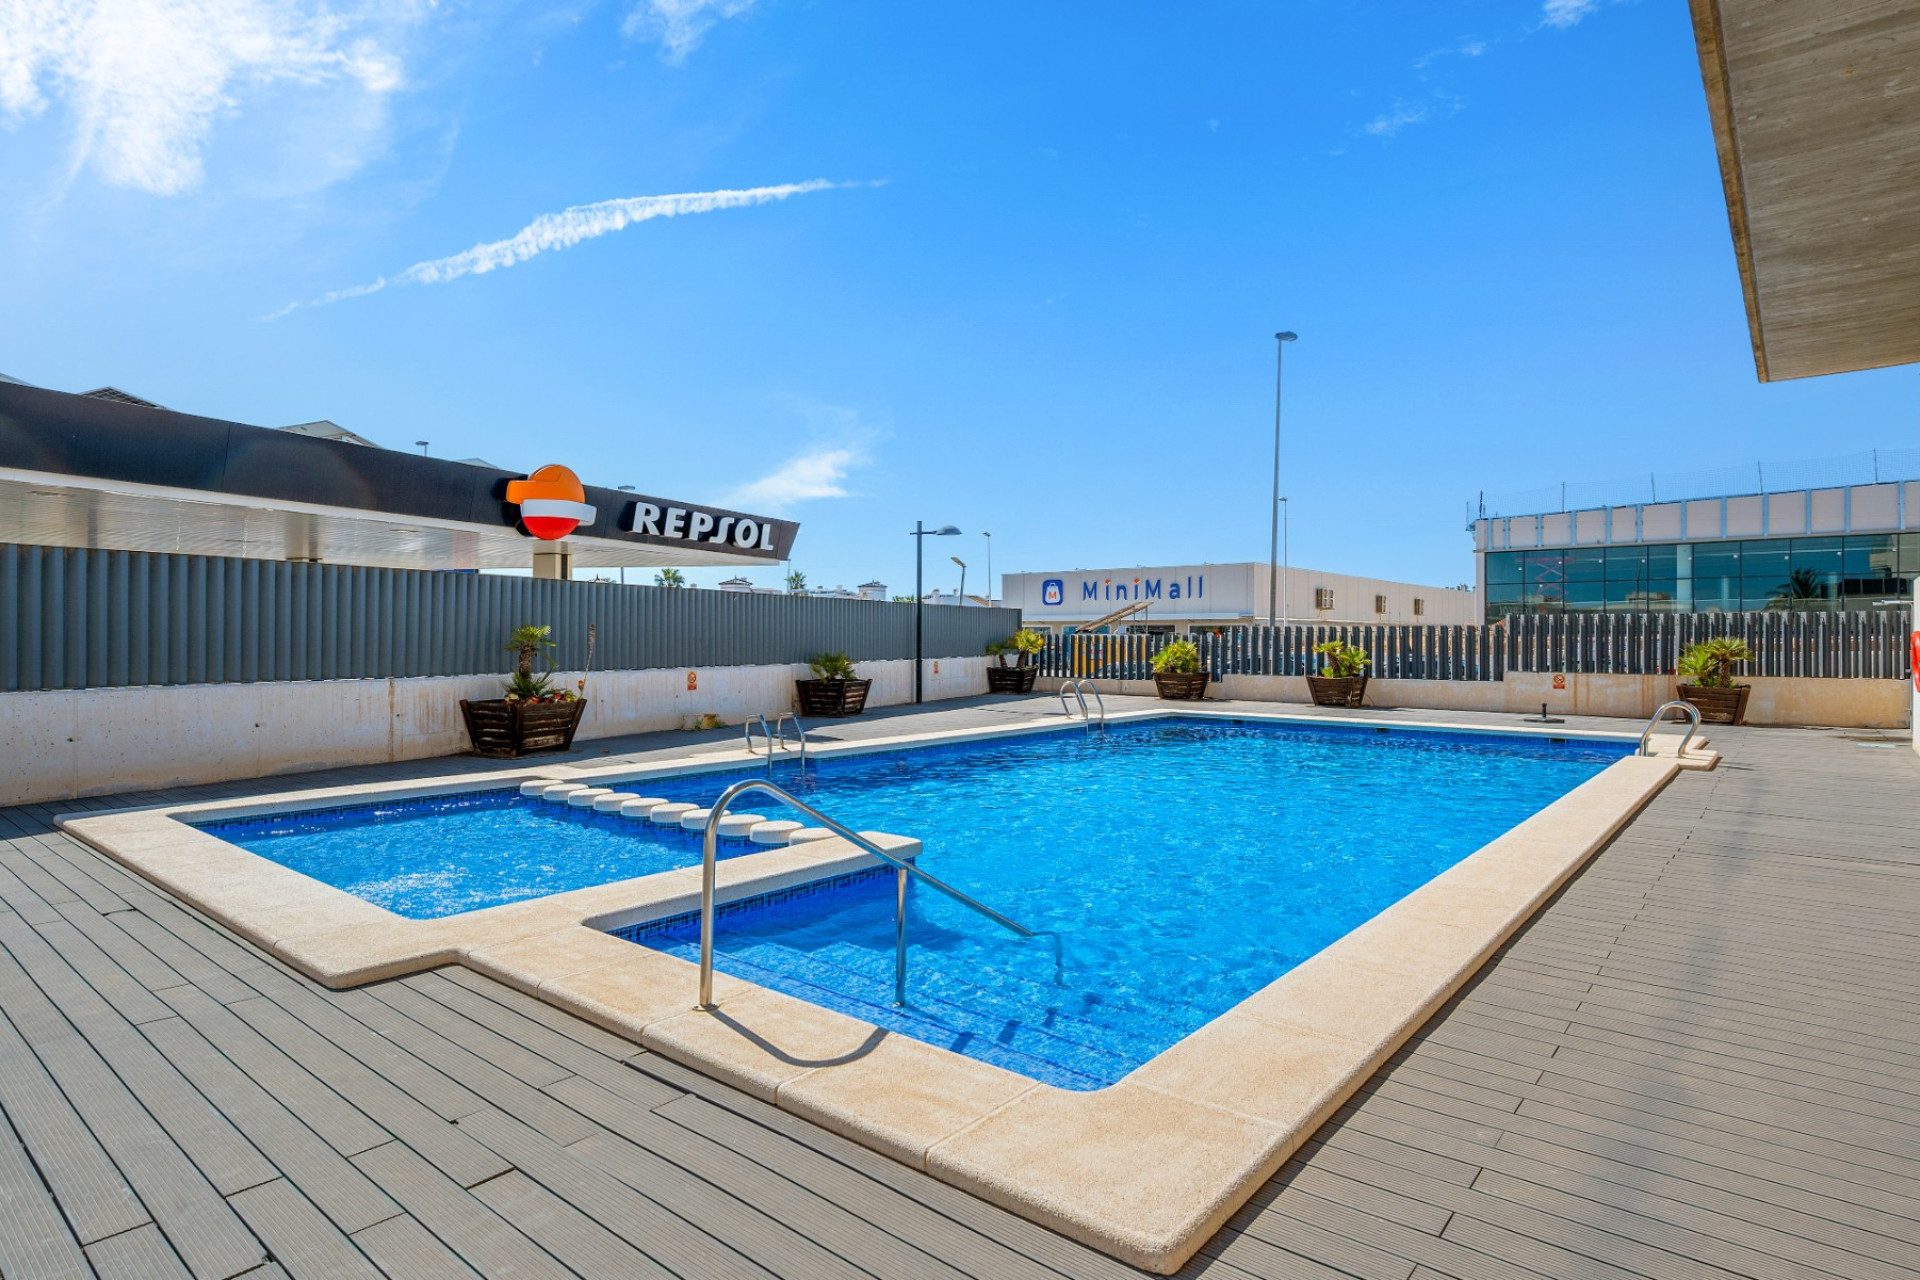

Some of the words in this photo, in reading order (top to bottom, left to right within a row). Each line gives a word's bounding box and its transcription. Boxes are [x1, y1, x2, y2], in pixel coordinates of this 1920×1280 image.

[632, 501, 774, 550] REPSOL
[1048, 591, 1057, 600] M
[1083, 575, 1203, 601] MiniMall
